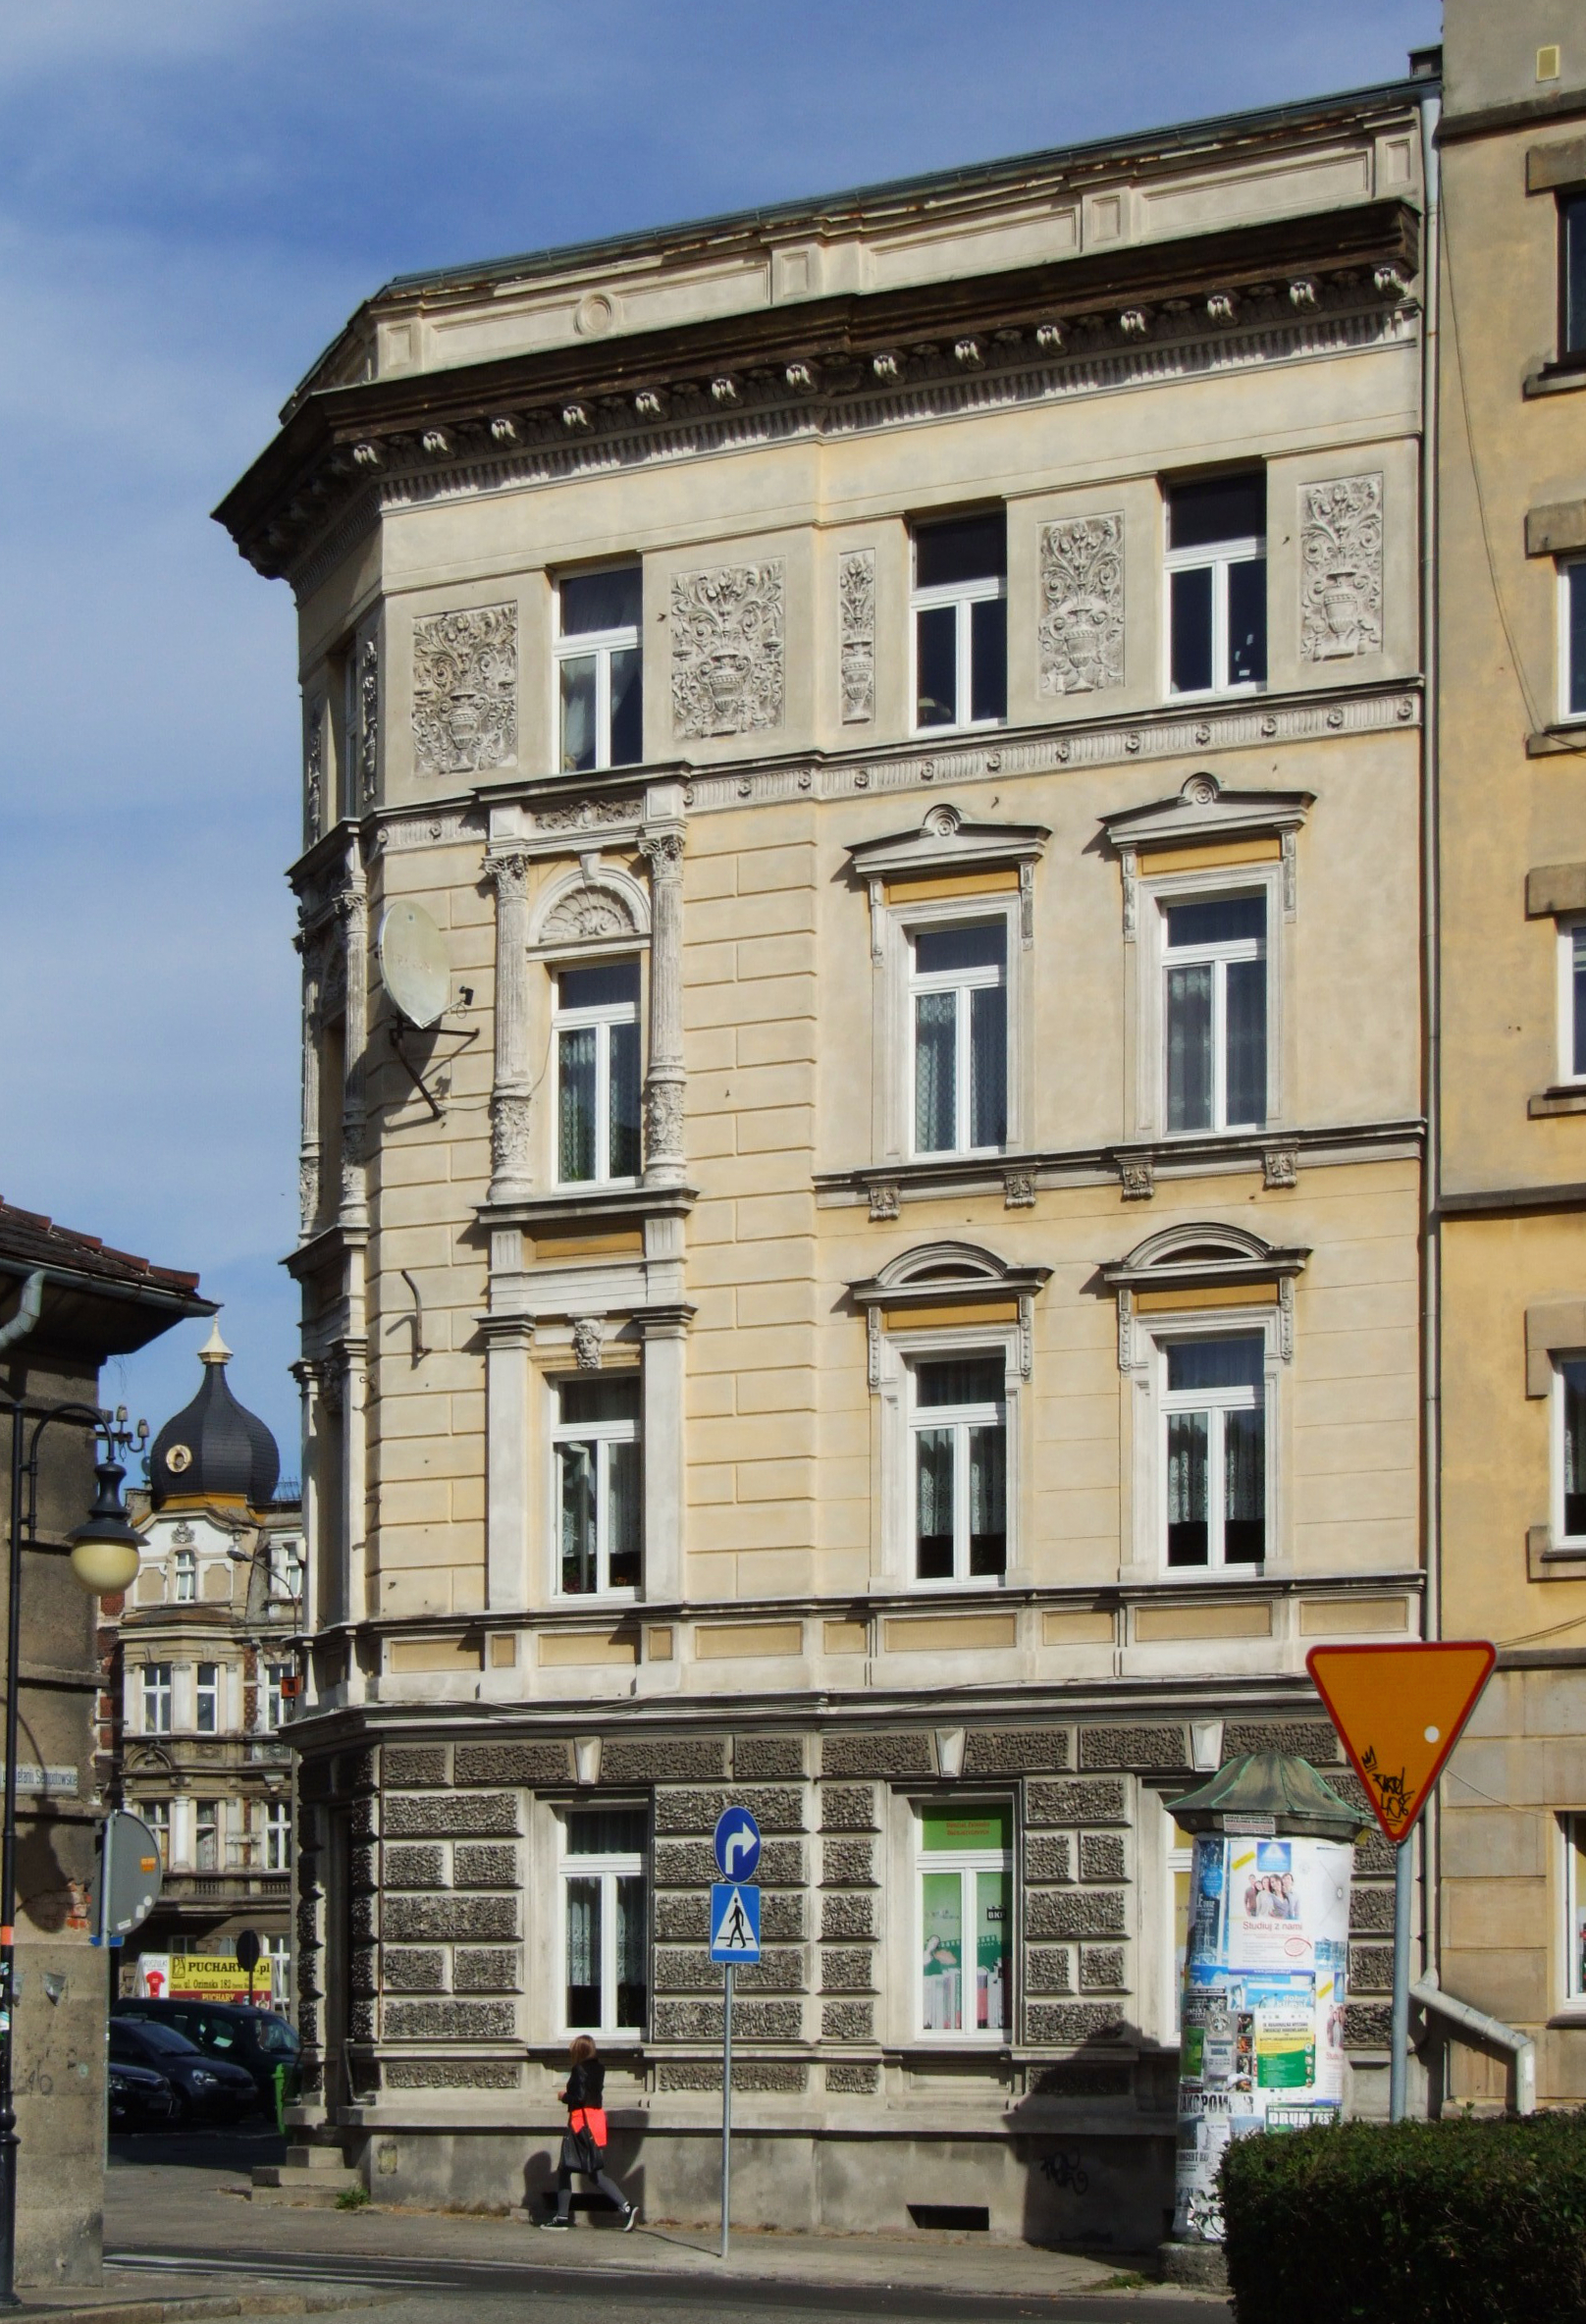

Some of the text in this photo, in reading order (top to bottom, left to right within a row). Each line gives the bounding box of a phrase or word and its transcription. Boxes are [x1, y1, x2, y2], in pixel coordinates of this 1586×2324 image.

[1242, 1922, 1272, 1931] Studiuj
[188, 1962, 270, 1976] PUCHARY.pl
[202, 1993, 236, 2002] PUCHARY
[1268, 2112, 1310, 2125] DRUM
